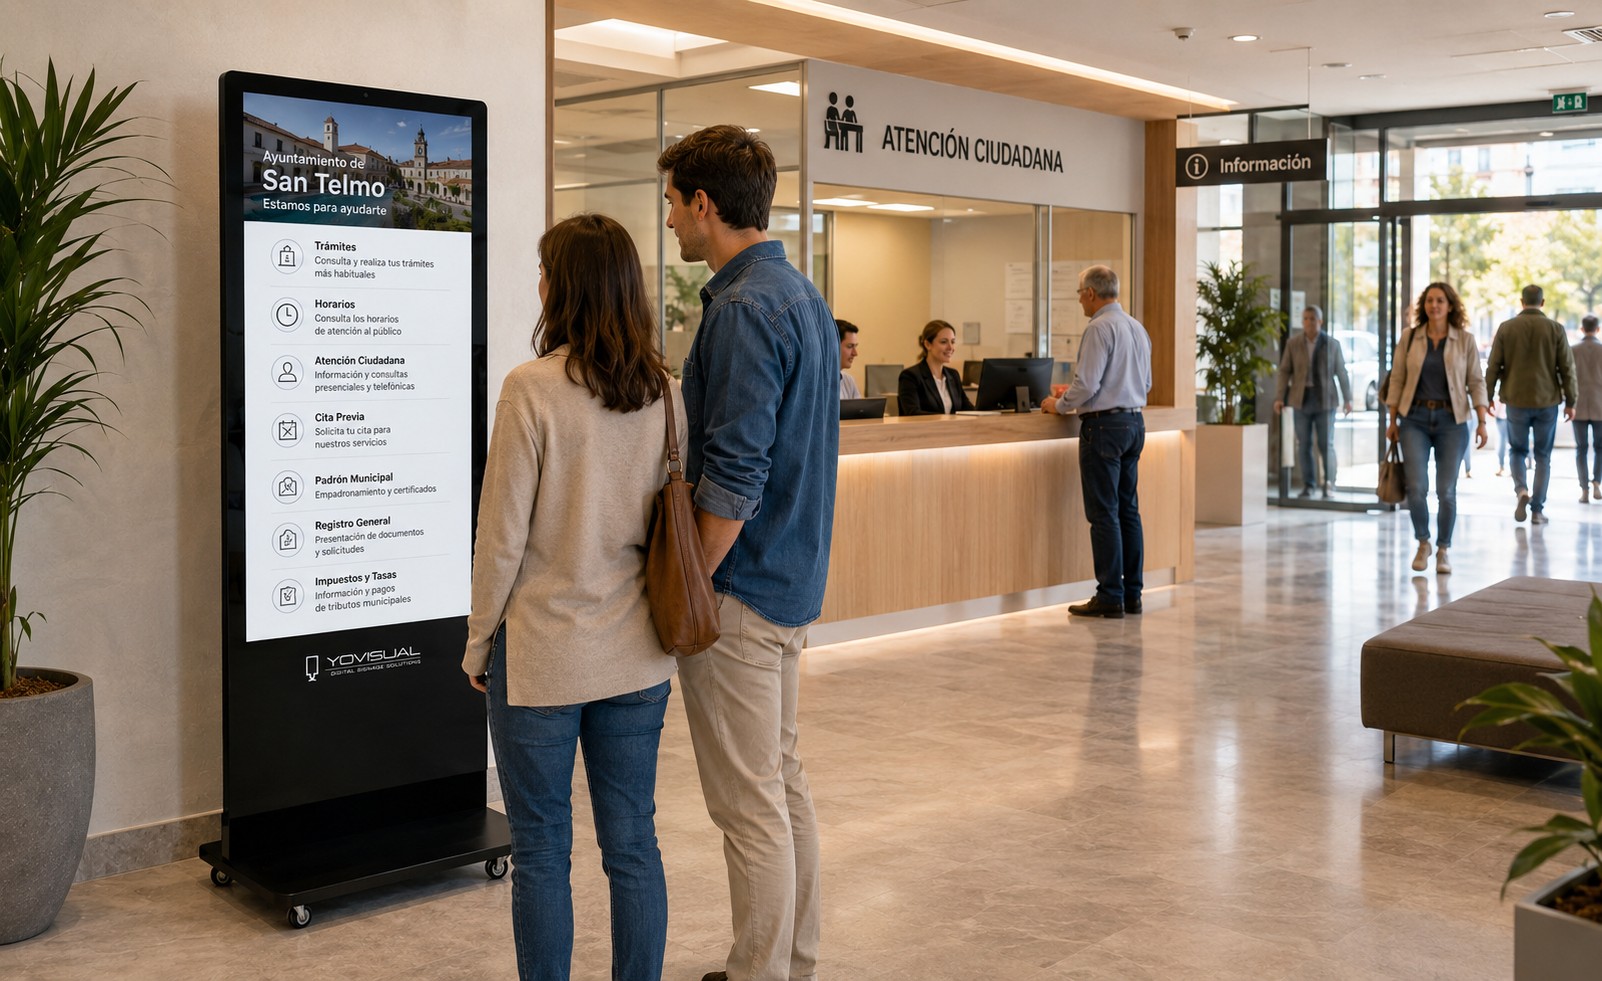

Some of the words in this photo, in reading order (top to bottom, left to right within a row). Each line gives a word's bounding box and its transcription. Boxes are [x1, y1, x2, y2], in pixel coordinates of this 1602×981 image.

[882, 125, 969, 160] ATENCIÓN
[974, 138, 1063, 173] CIUDADANA
[263, 150, 347, 167] Ayuntamiento
[350, 158, 365, 170] de
[1220, 153, 1311, 173] Información
[263, 169, 307, 192] San
[314, 173, 385, 197] Telmo
[263, 198, 310, 211] Estamos
[314, 204, 337, 214] para
[340, 204, 387, 216] ayudarte
[315, 241, 356, 251] Trámites
[315, 256, 351, 265] Consulta
[353, 259, 358, 267] y
[360, 258, 386, 267] realiza
[388, 259, 400, 267] tus
[402, 259, 434, 268] trámites
[315, 269, 332, 277] más
[334, 269, 376, 279] habituales
[315, 299, 355, 309] Horarios
[315, 314, 351, 322] Consulta
[353, 314, 365, 323] los
[367, 315, 399, 323] horarios
[315, 327, 325, 335] de
[327, 327, 362, 335] atención
[364, 327, 371, 335] al
[373, 327, 402, 337] público
[315, 356, 356, 365] Atención
[358, 356, 405, 365] Ciudadana
[315, 370, 363, 379] Información
[364, 372, 370, 380] y
[371, 370, 408, 378] consultas
[315, 383, 365, 393] presenciales
[366, 385, 372, 393] y
[373, 382, 415, 391] telefónicas
[315, 413, 334, 422] Cita
[336, 412, 365, 421] Previa
[315, 427, 345, 436] Solicita
[357, 426, 372, 435] cita
[373, 427, 391, 436] para
[315, 440, 351, 448] nuestros
[352, 438, 387, 447] servicios
[315, 475, 348, 485] Padrón
[350, 472, 393, 483] Municipal
[315, 488, 386, 500] Empadronamiento
[387, 489, 392, 497] y
[393, 485, 437, 494] certificados
[315, 520, 354, 531] Registro
[356, 516, 390, 527] General
[315, 532, 365, 543] Presentación
[367, 532, 377, 540] de
[378, 529, 424, 539] documentos
[315, 550, 320, 558] y
[322, 545, 365, 556] solicitudes
[315, 575, 363, 587] Impuestos
[364, 575, 370, 583] y
[372, 572, 397, 580] Tasas
[315, 589, 363, 600] Información
[365, 589, 370, 597] y
[371, 586, 395, 596] pagos
[315, 603, 326, 612] de
[328, 601, 361, 611] tributos
[363, 596, 411, 607] municipales
[327, 646, 421, 668] YOVISUAL
